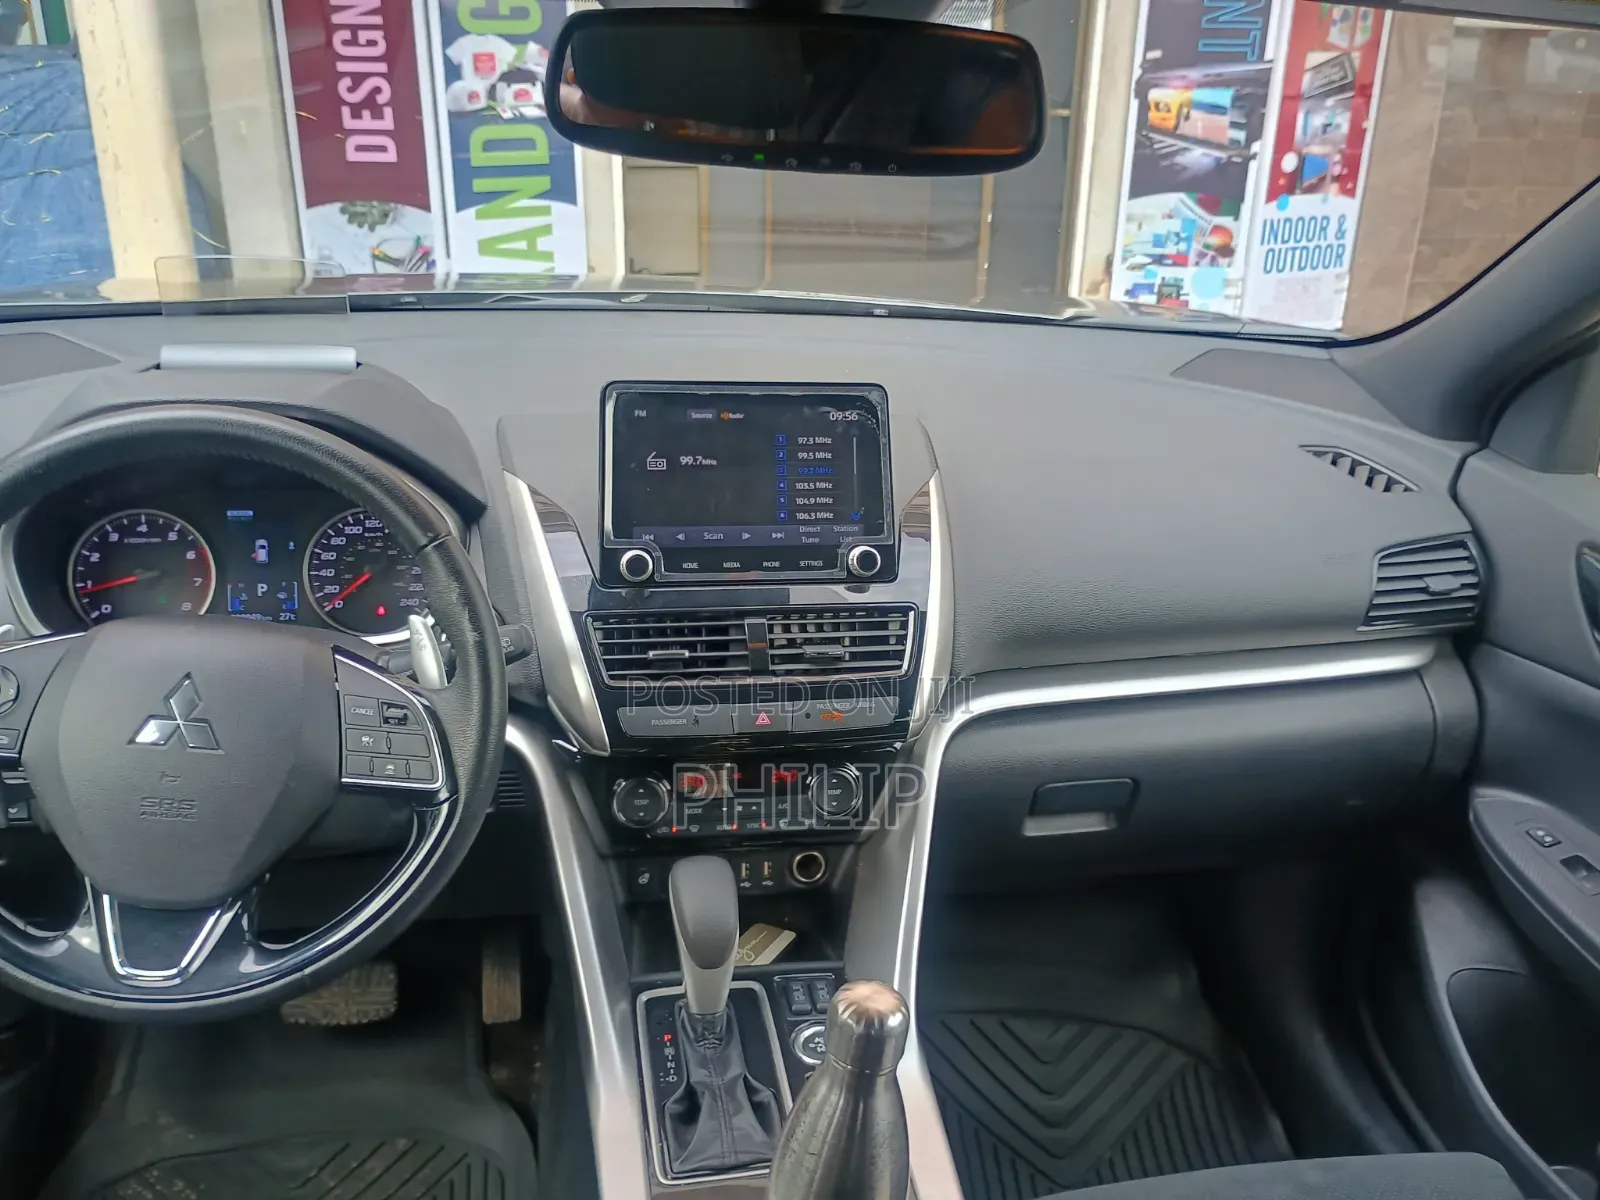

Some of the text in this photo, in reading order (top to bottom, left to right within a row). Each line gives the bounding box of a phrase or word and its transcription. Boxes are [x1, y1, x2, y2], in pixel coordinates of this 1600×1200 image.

[1260, 214, 1347, 246] INDOOR &
[1263, 243, 1345, 274] OUTDOOR
[634, 409, 647, 418] FM
[829, 411, 858, 421] 09:56
[797, 437, 814, 445] 97.3
[815, 436, 832, 444] MHz
[797, 452, 814, 460] 99.5
[815, 466, 833, 474] MHz
[795, 482, 815, 490] 103.5
[795, 497, 815, 505] 104.9
[795, 512, 816, 520] 106.3
[136, 524, 148, 533] 4
[344, 526, 363, 534] 100
[799, 525, 821, 533] Direct
[108, 532, 119, 542] 3
[167, 532, 179, 541] 5
[703, 531, 724, 540] Scan
[330, 537, 346, 545] 80
[801, 536, 820, 544] Tune
[90, 552, 100, 562] 2
[186, 550, 196, 560] 6
[320, 552, 337, 560] 60
[319, 569, 335, 577] 40
[86, 580, 92, 588] 1
[193, 578, 203, 587] 7
[257, 583, 269, 597] P
[323, 585, 340, 593] 20
[181, 602, 192, 611] 8
[334, 600, 343, 608] 0
[400, 598, 419, 607] 240
[101, 604, 112, 614] 0
[350, 707, 375, 716] CANCEL
[651, 718, 688, 726] PASSENGER
[664, 1034, 672, 1042] P
[667, 1061, 676, 1069] N
[669, 1075, 678, 1083] D
